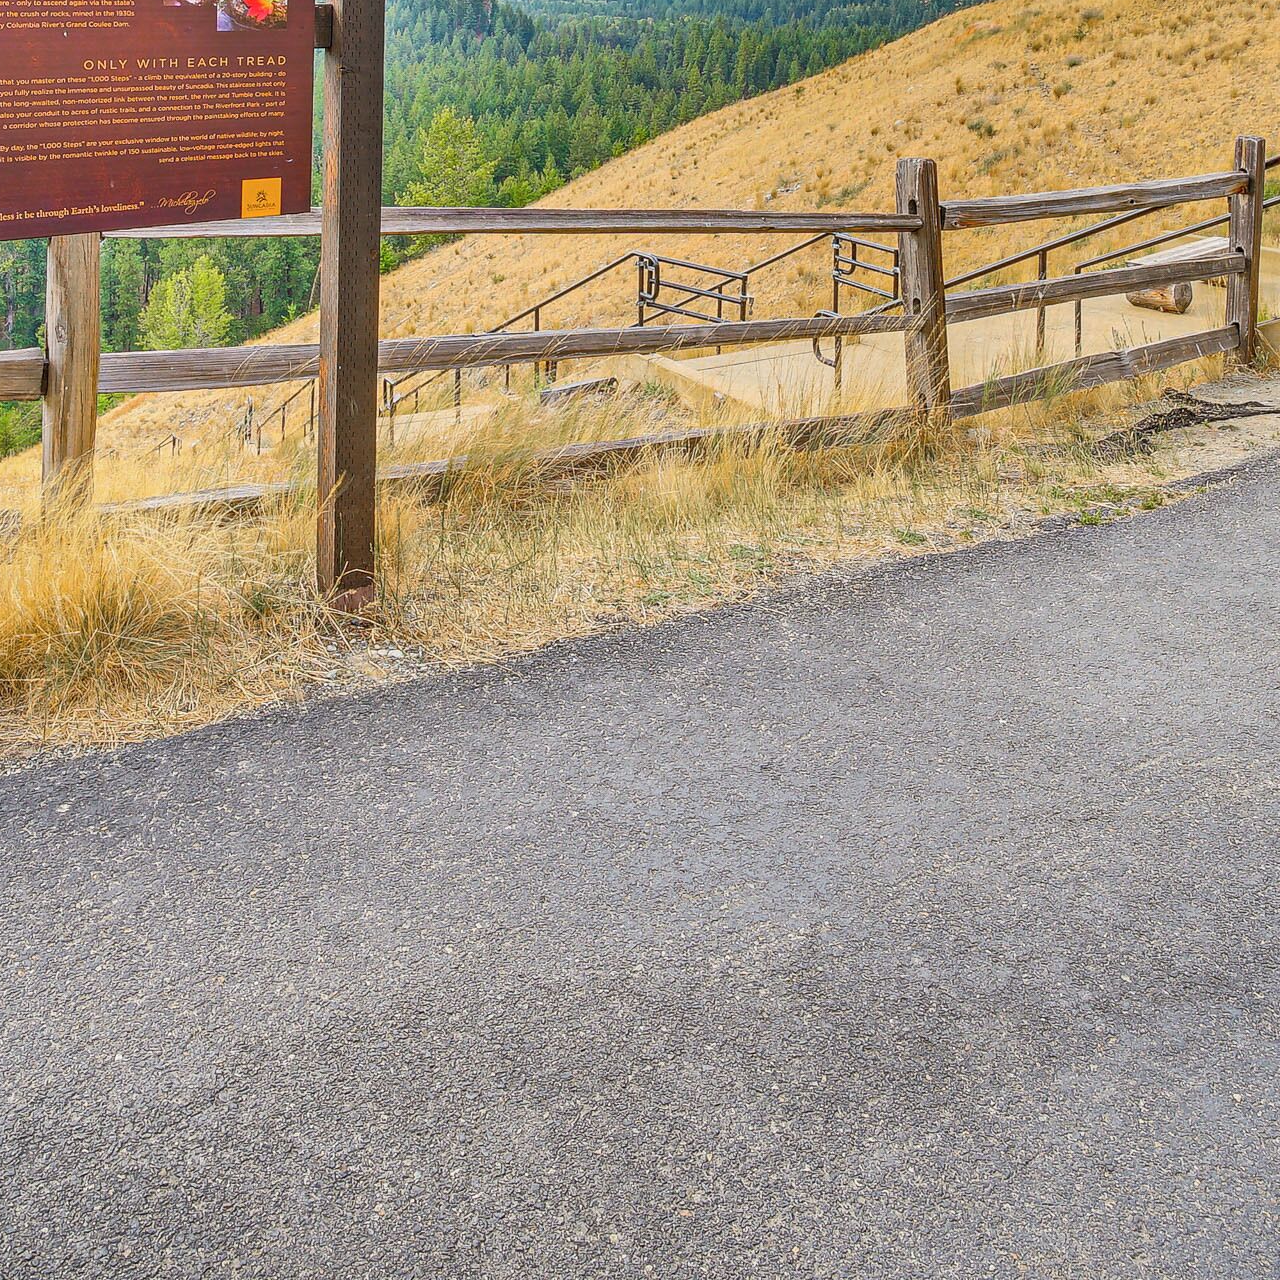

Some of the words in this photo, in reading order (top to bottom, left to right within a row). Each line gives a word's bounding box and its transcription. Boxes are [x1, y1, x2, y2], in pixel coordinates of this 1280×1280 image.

[84, 59, 128, 70] ONLY
[137, 58, 179, 68] WITH
[188, 57, 229, 67] EACH
[238, 55, 286, 66] TREAD
[16, 211, 22, 220] it
[24, 210, 34, 219] be
[36, 207, 69, 221] through
[70, 204, 99, 215] Earth's
